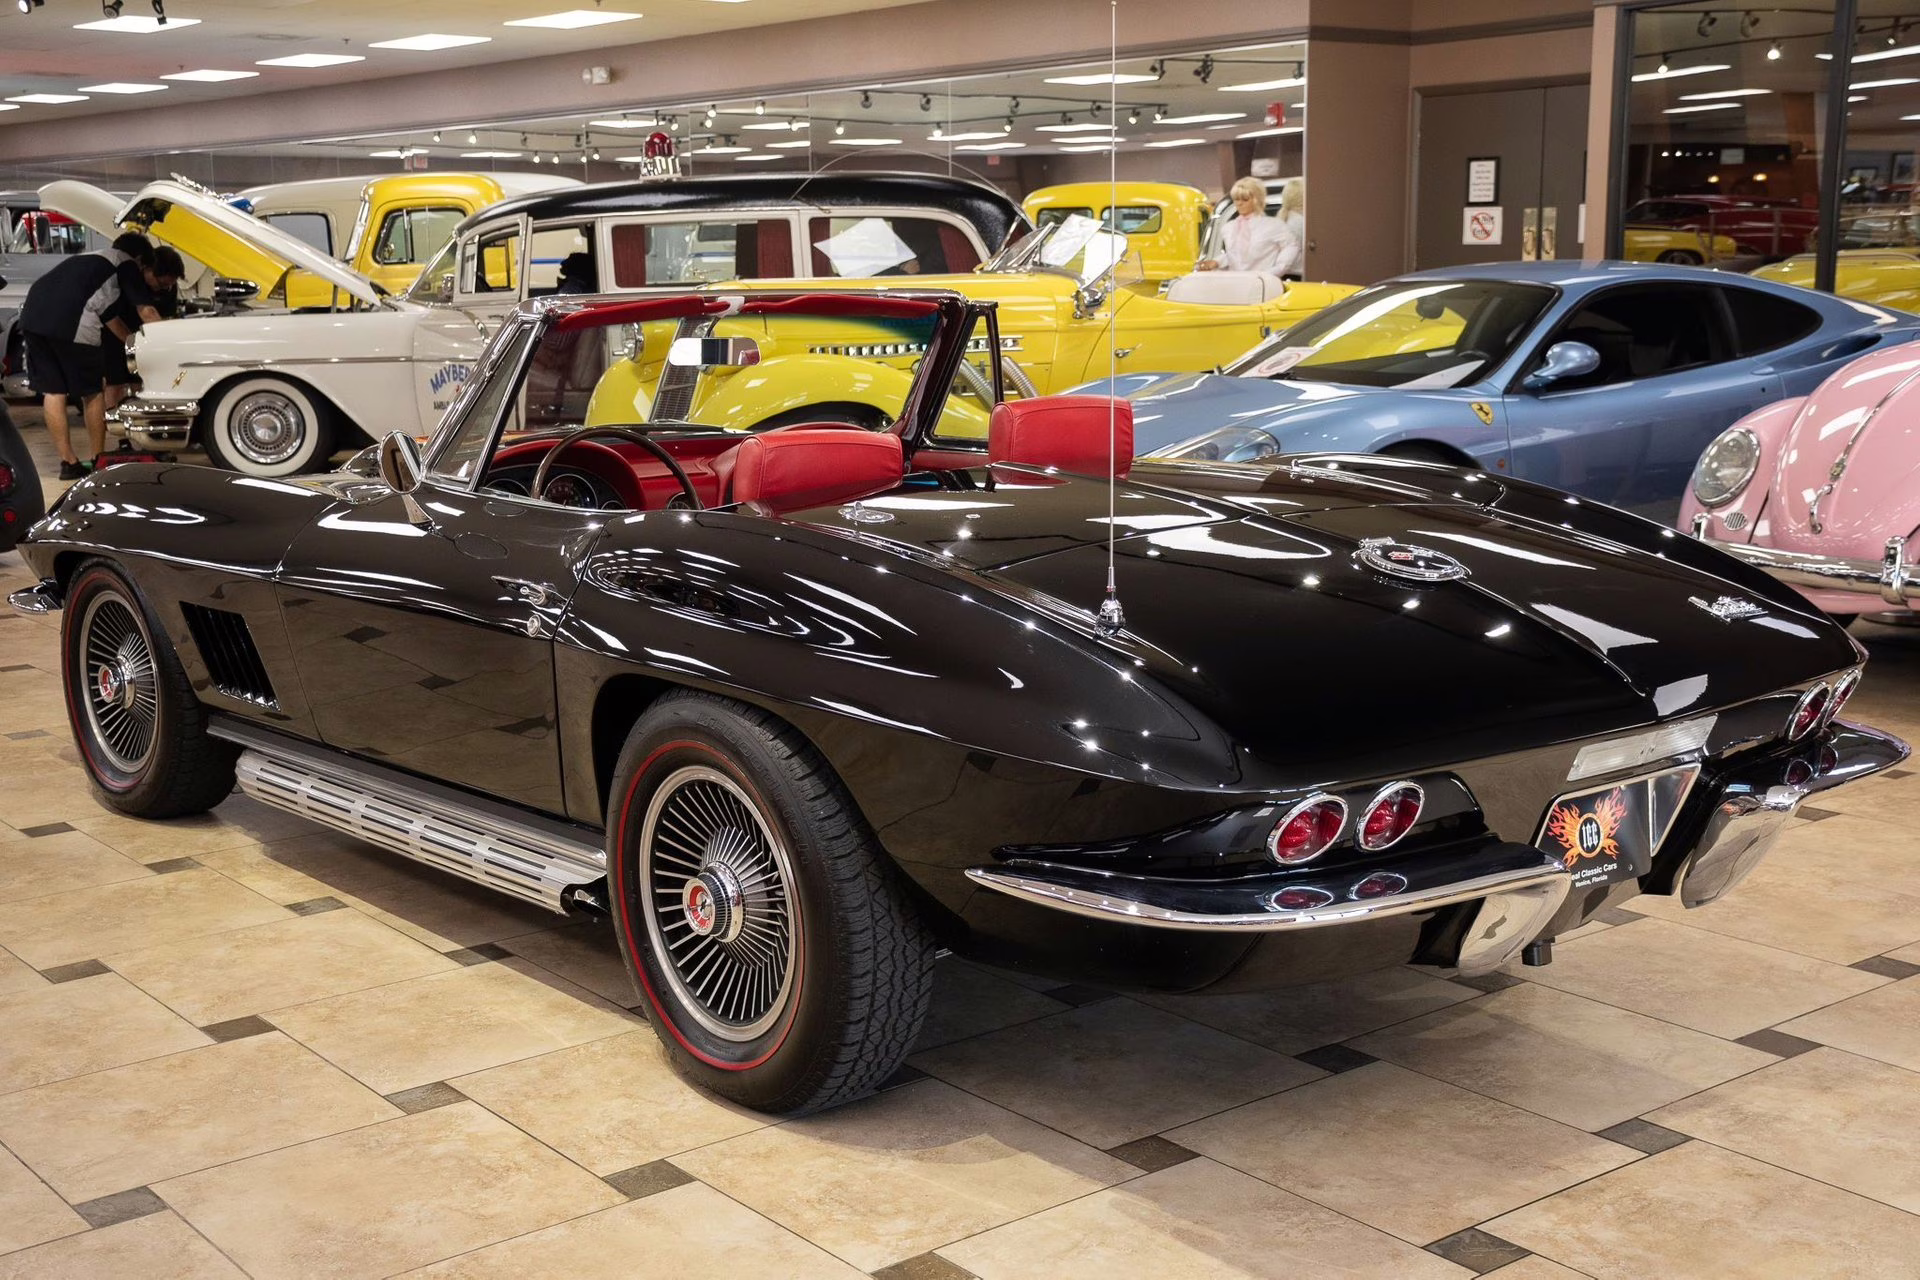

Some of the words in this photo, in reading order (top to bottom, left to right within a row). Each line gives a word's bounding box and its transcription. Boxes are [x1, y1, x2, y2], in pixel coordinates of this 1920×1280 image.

[1571, 871, 1581, 881] eal
[1581, 866, 1603, 878] Classic
[1603, 863, 1618, 872] Cars
[1591, 873, 1608, 883] Florida
